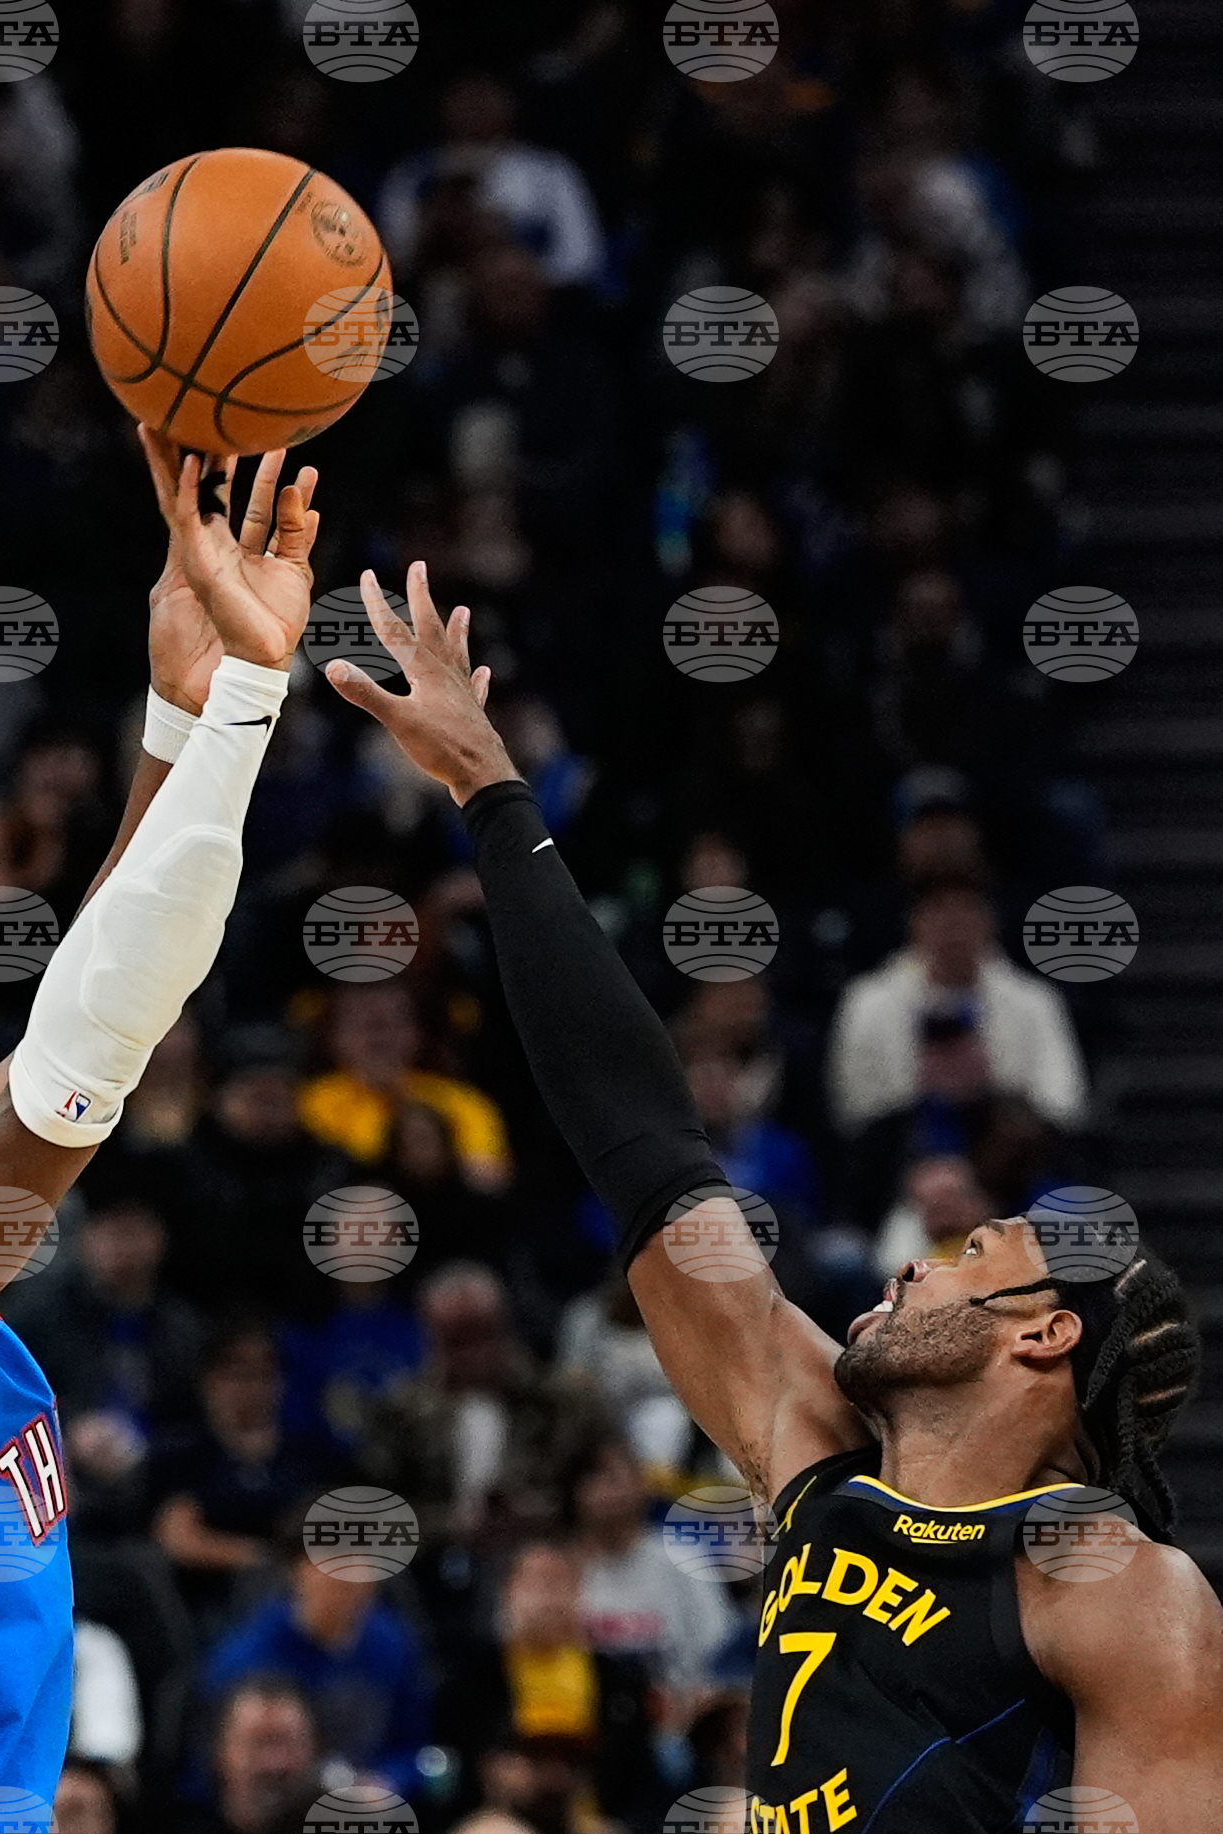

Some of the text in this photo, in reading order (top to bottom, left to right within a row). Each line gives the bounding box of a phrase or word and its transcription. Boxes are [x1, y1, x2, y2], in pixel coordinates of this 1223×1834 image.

[893, 1514, 986, 1541] Rakuten
[758, 1543, 951, 1647] GOLDEN
[770, 1632, 837, 1767] 7
